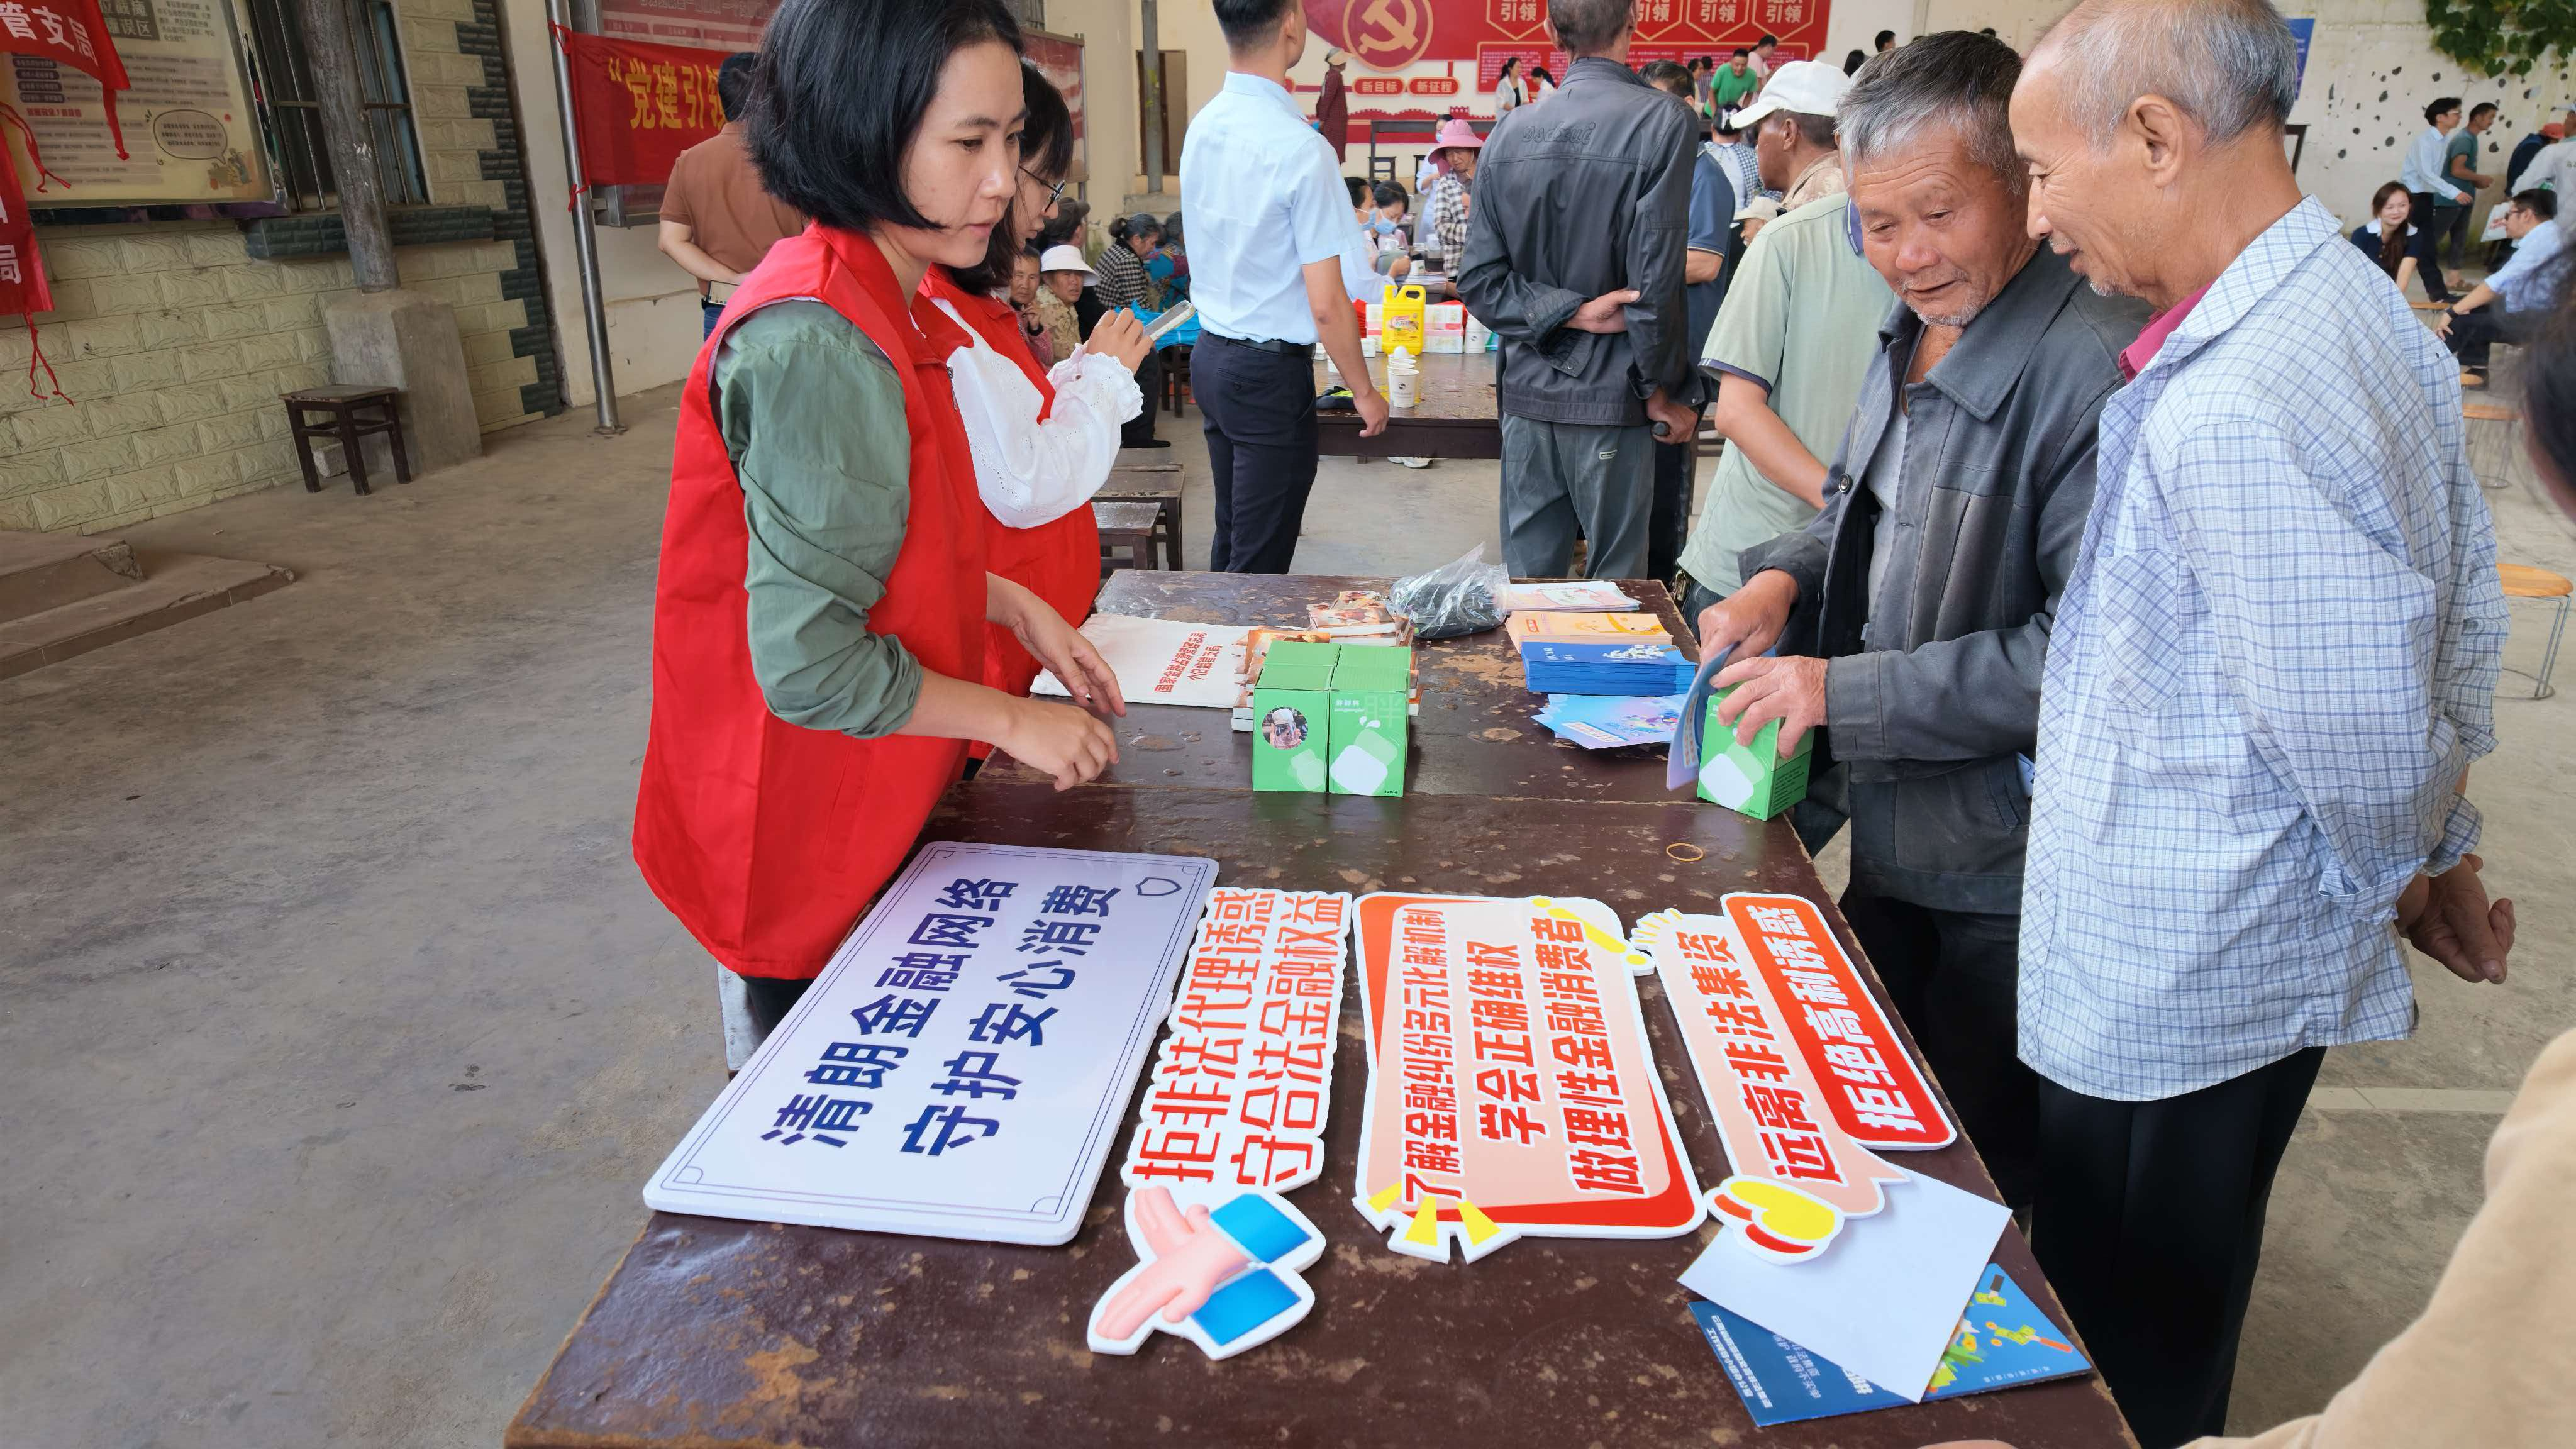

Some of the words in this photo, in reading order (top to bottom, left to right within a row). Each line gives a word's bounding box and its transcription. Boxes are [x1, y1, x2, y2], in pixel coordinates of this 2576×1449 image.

[0, 1, 99, 66] 管支局
[1362, 80, 1397, 92] 新目标
[1417, 80, 1452, 92] 新征程
[1501, 3, 1537, 22] 引领
[1700, 4, 1737, 23] 引领
[1766, 4, 1803, 23] 引领
[1154, 631, 1208, 692] 国家金融监督管理总局
[1187, 645, 1223, 681] 个旧监管支局
[760, 877, 1018, 1149] 清朗金融网络
[899, 884, 1121, 1157] 守护安心消费
[1132, 891, 1276, 1183] 拒非法代理诱惑
[1231, 894, 1344, 1187] 守合法金融权益
[1402, 908, 1463, 1202] 了解金融纠纷多元化解机制
[1467, 941, 1546, 1145] 学会正确维权
[1530, 917, 1645, 1195] 做理性金融消费者
[1675, 931, 1847, 1185] 远离非法集资
[1746, 905, 1926, 1134] 拒绝高利诱惑
